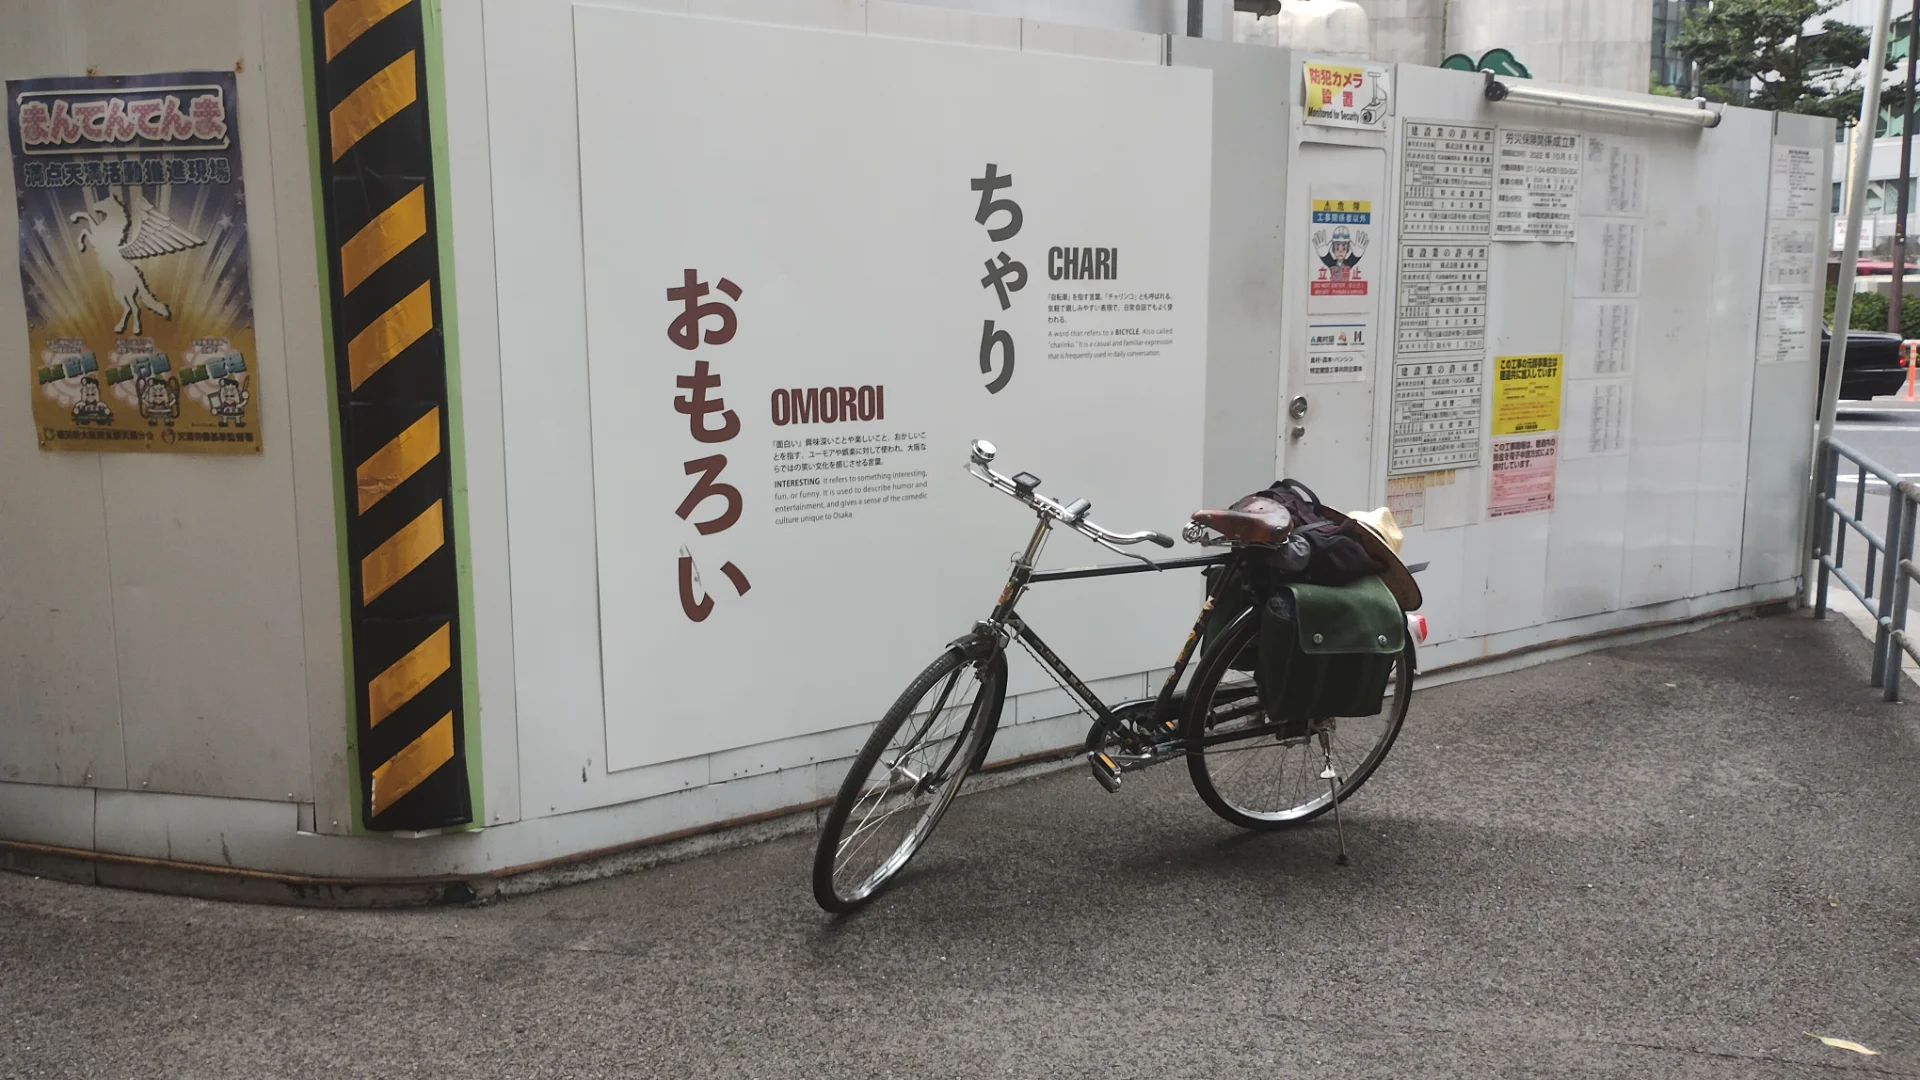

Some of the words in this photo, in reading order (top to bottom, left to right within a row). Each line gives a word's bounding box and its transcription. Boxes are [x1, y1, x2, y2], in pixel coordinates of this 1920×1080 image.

[1309, 67, 1363, 88] 防犯カメラ
[20, 95, 227, 144] まんてんてんま
[1308, 106, 1333, 119] Monitored
[1341, 109, 1359, 123] Security
[24, 158, 231, 187] 満点天満活動推進現場
[1048, 246, 1118, 281] CHARI
[971, 163, 1028, 394] ちゃり
[771, 385, 884, 426] OMOROI
[667, 269, 751, 623] おもろい
[857, 472, 892, 483] something
[775, 493, 789, 501] fun,
[863, 484, 891, 493] describe
[841, 500, 857, 508] gives
[902, 493, 928, 501] comedic
[775, 516, 799, 525] culture
[800, 514, 823, 523] unique
